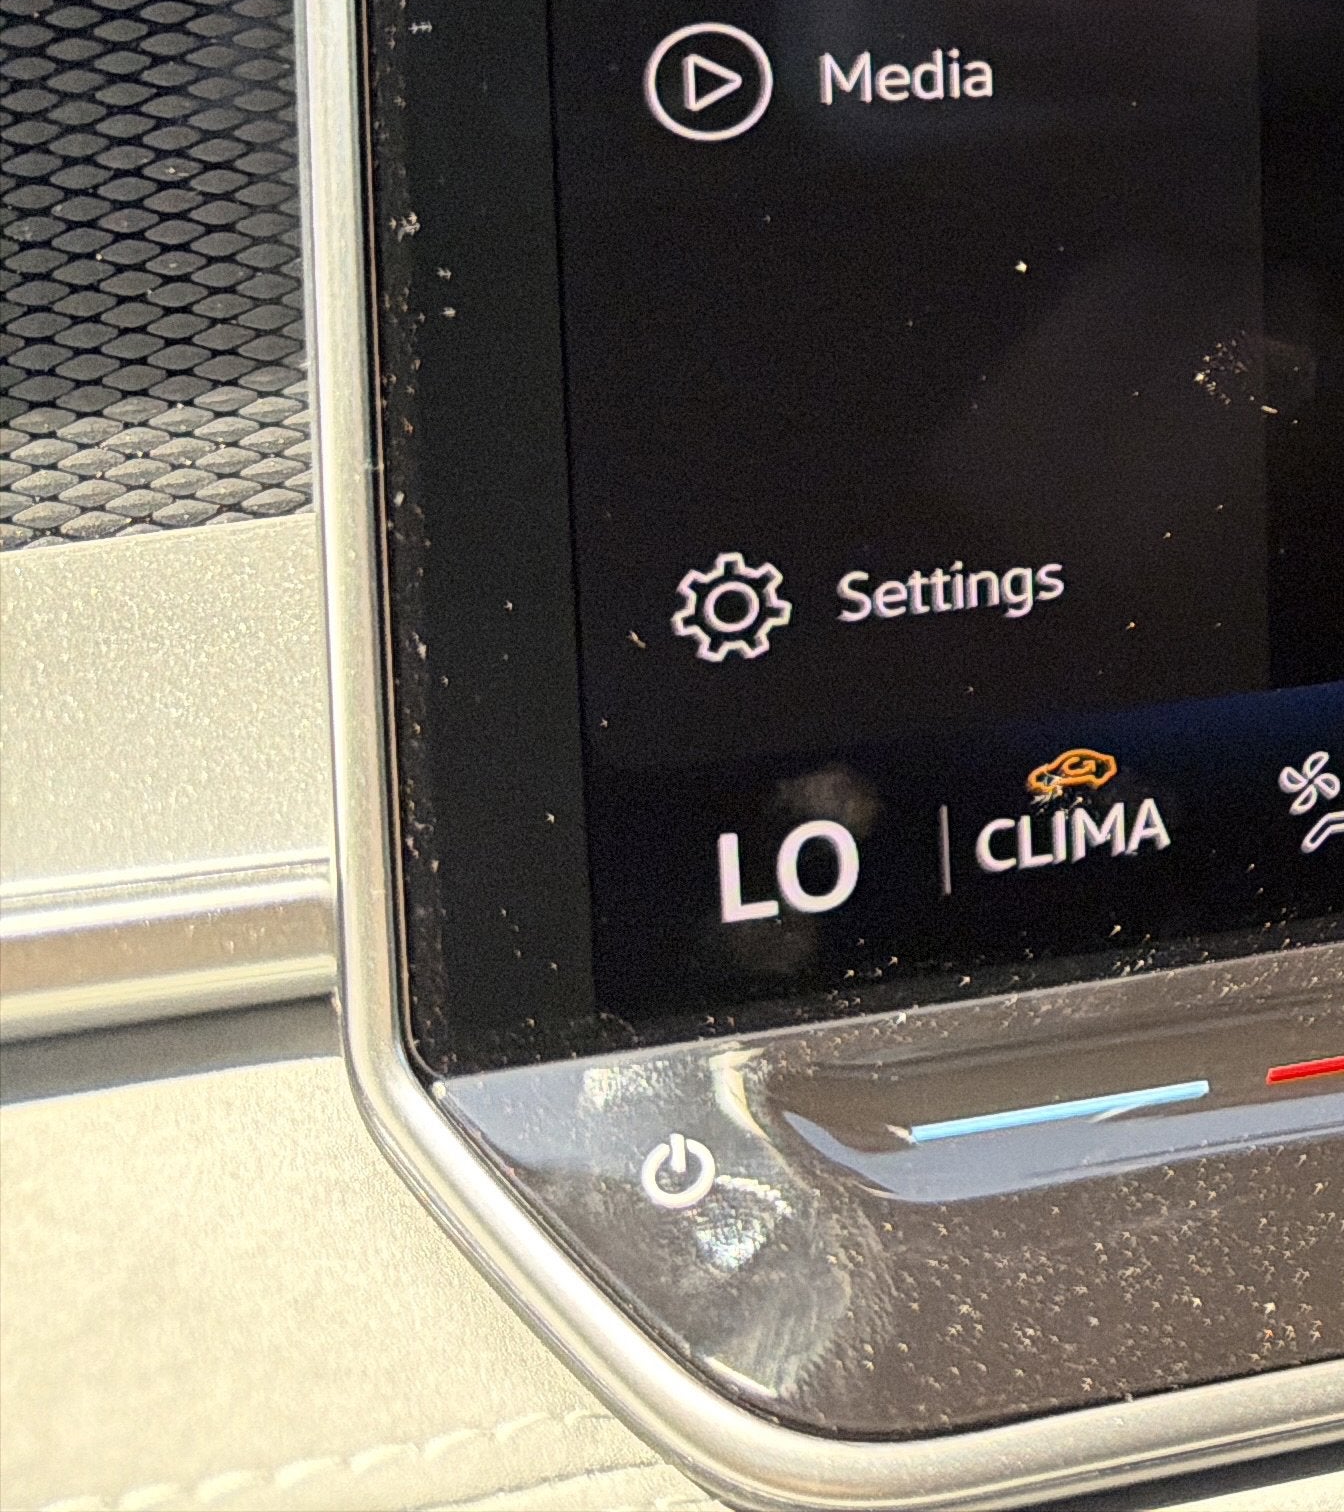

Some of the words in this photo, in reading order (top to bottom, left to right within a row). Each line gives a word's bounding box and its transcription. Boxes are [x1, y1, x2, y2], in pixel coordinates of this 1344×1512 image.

[819, 48, 995, 106] Media
[836, 560, 1066, 623] Settings
[975, 798, 1171, 873] CLIMA
[716, 820, 860, 924] LO
